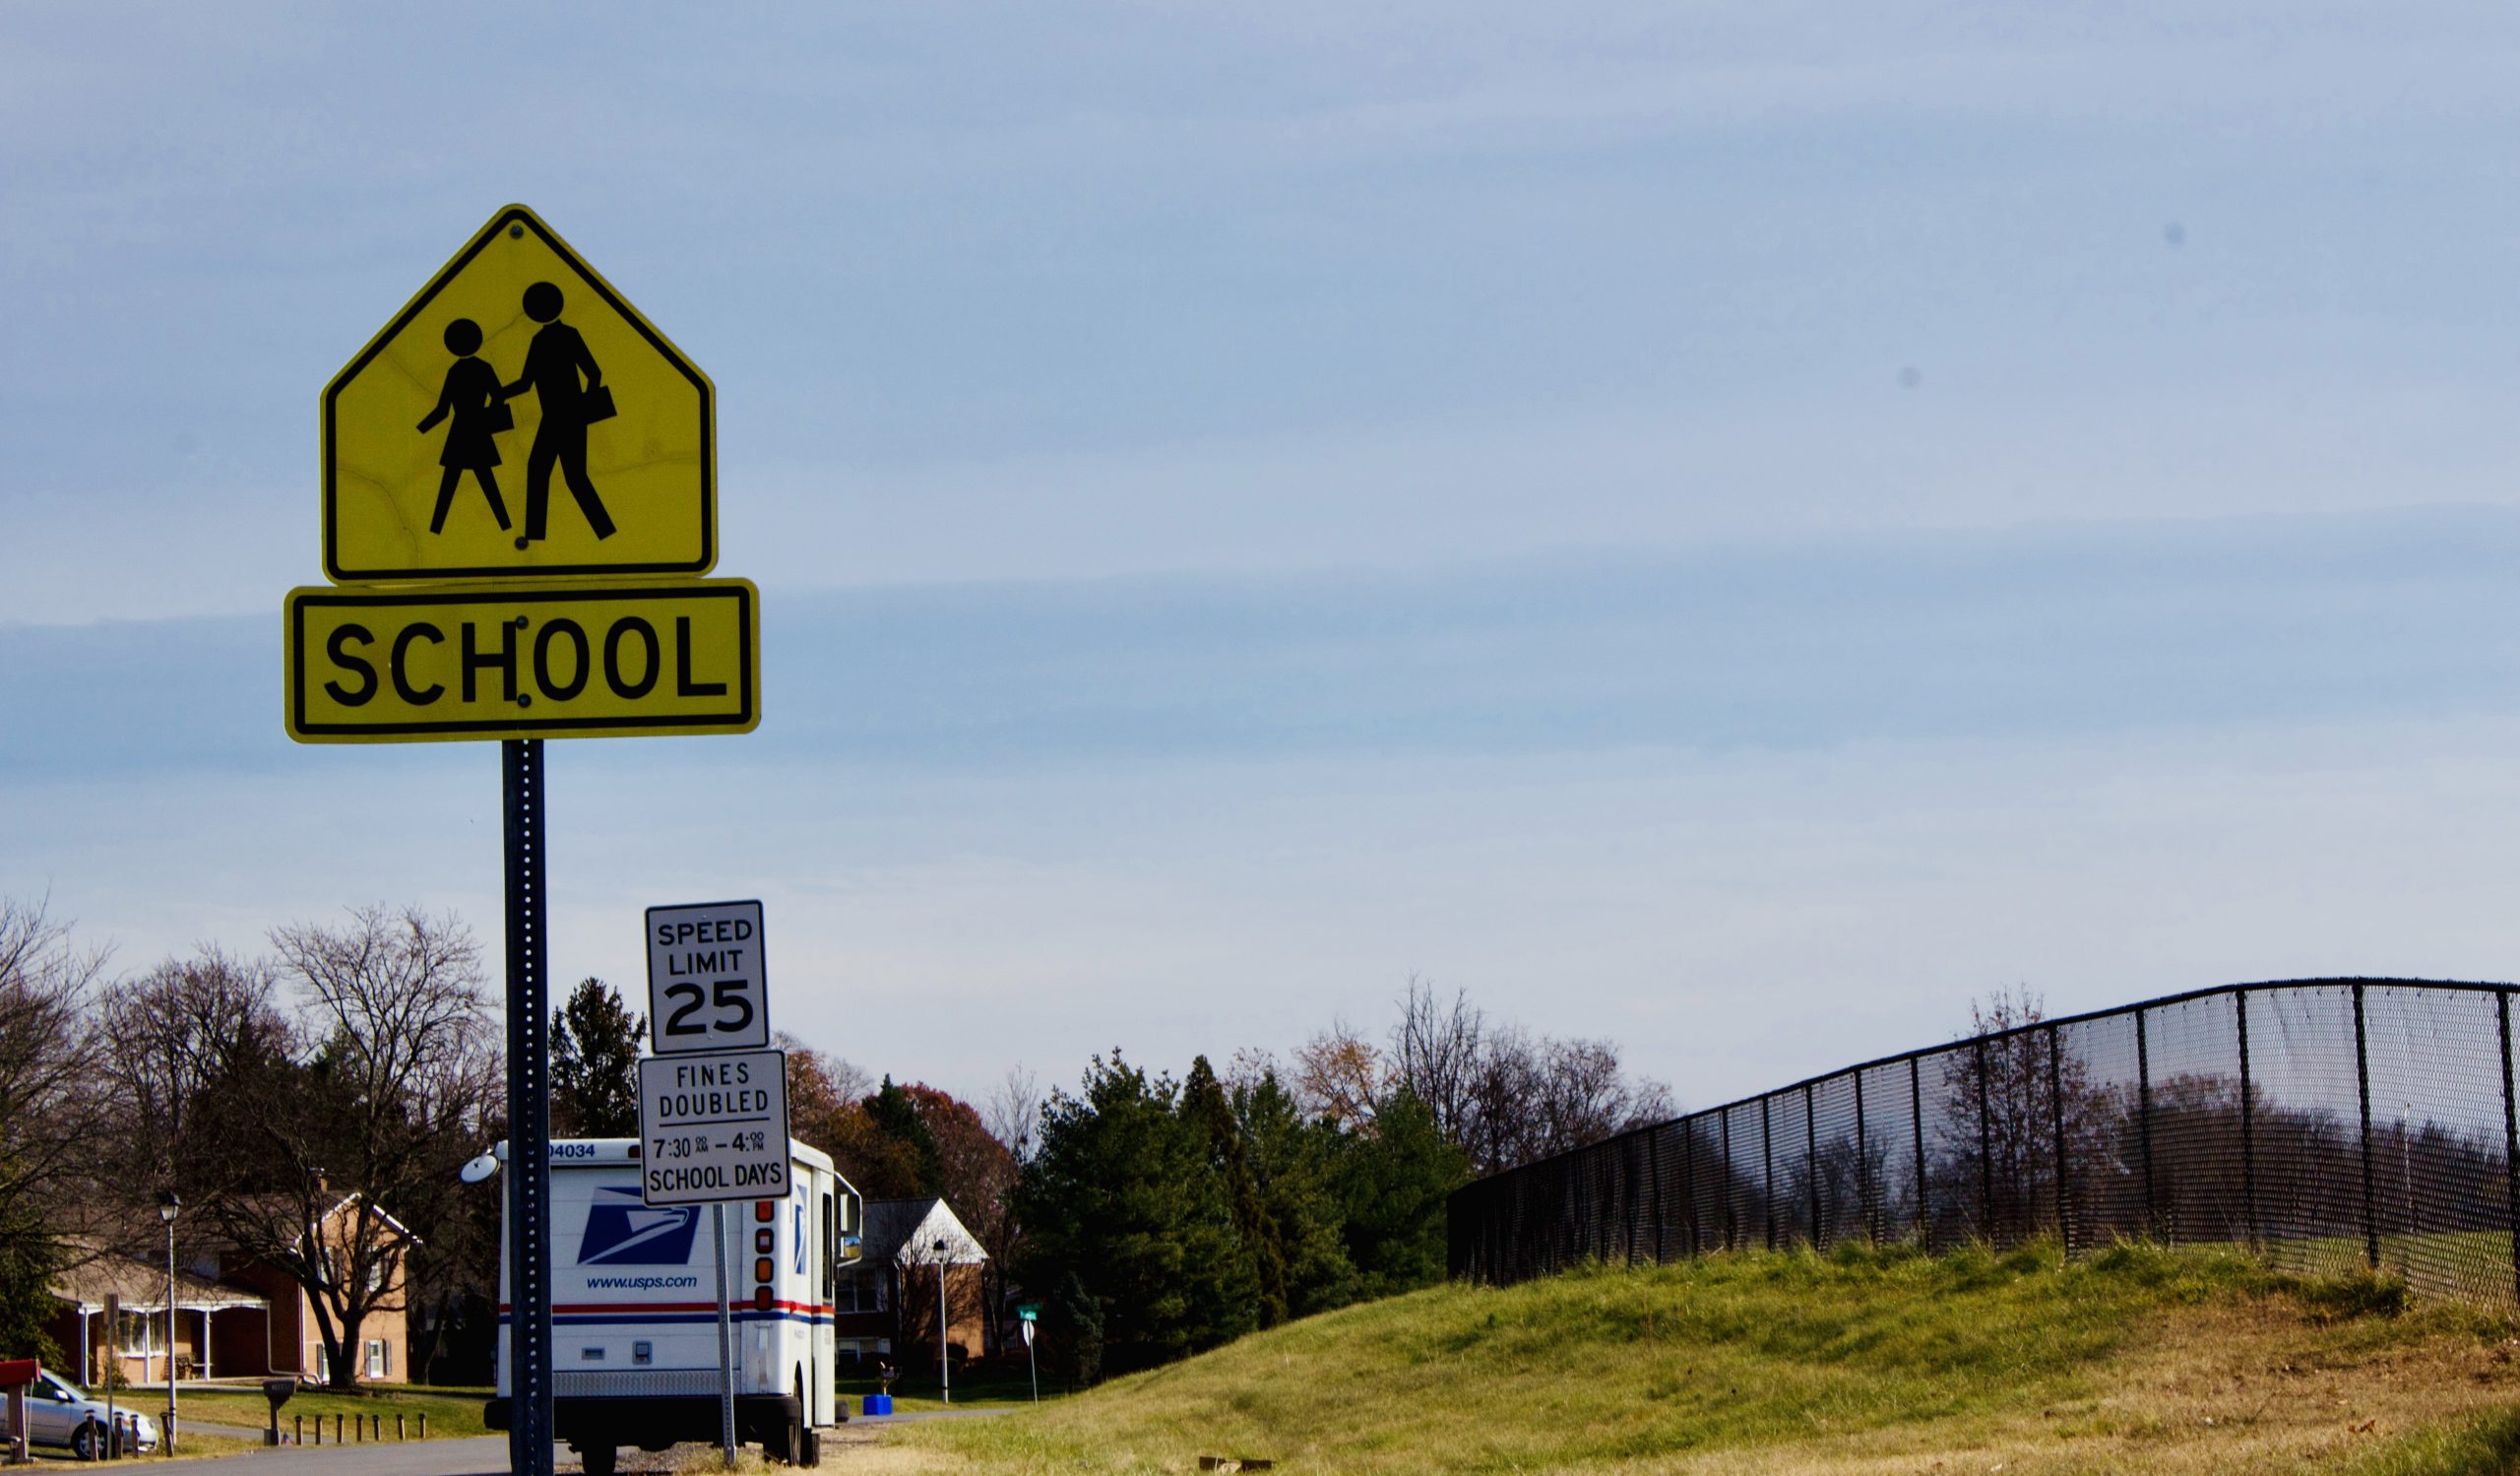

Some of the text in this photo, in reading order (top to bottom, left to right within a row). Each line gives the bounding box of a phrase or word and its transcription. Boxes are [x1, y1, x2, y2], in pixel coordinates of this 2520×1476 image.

[324, 615, 727, 707] SCHOOL
[658, 919, 753, 946] SPEED
[668, 949, 743, 976] LIMIT
[663, 979, 754, 1037] 25
[676, 1062, 749, 1088] FINES
[660, 1089, 768, 1118] DOUBLED
[653, 1137, 691, 1159] 7:30
[650, 1162, 782, 1191] SCHOOL DAYS
[587, 1276, 698, 1291] www.usps.com
